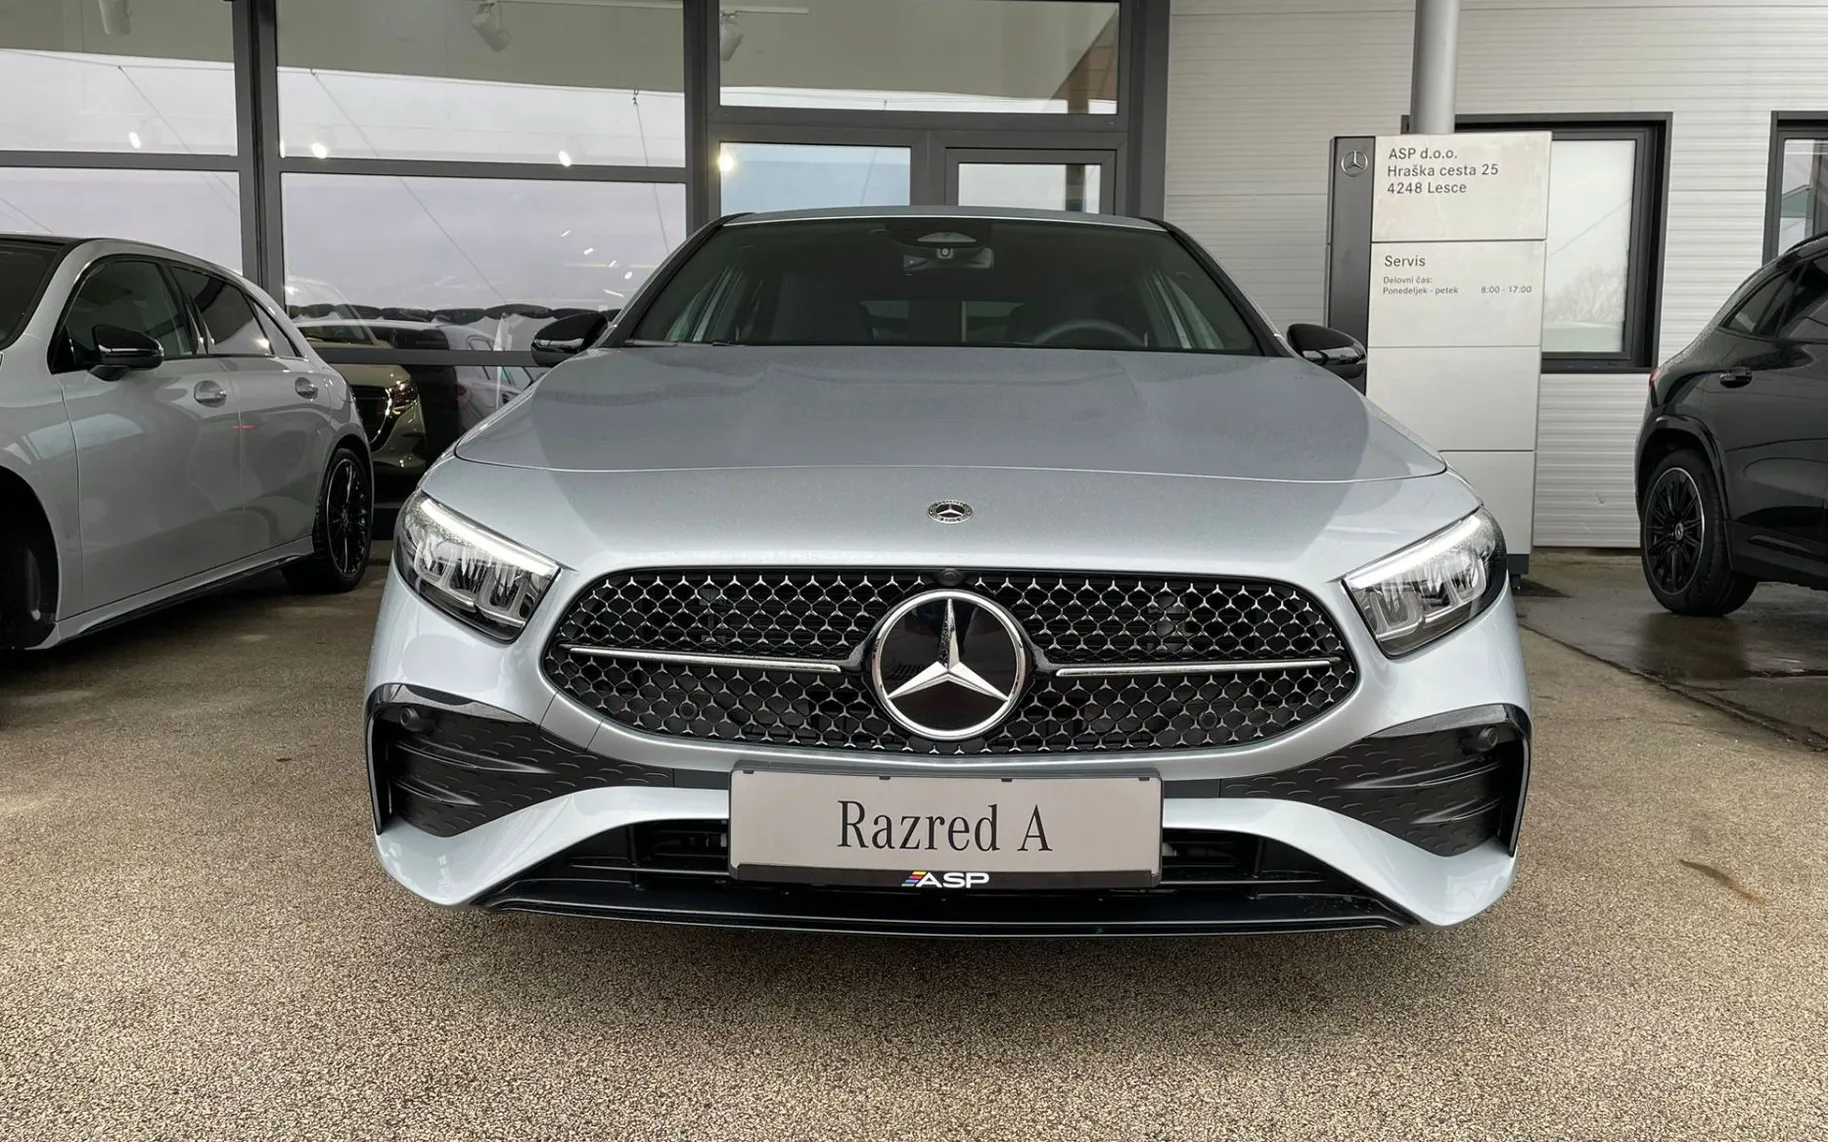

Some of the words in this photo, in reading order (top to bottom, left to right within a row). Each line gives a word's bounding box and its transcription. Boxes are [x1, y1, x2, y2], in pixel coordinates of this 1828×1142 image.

[1388, 148, 1416, 160] ASP
[1420, 147, 1458, 160] d.o.o.
[1387, 164, 1435, 177] Hraška
[1439, 165, 1477, 176] cesta
[1481, 163, 1499, 176] 25
[1387, 182, 1423, 194] 4248
[1427, 182, 1467, 194] Lesce
[1384, 255, 1426, 267] Servis
[1383, 276, 1414, 284] Delovni
[1416, 275, 1433, 284] čas:
[1383, 286, 1427, 296] Ponedeljek
[1435, 286, 1459, 296] petek
[1481, 285, 1500, 294] 8:00
[1508, 285, 1532, 294] 17:00
[836, 799, 1001, 852] Razred
[1016, 803, 1054, 852] A
[914, 871, 991, 889] ASP
